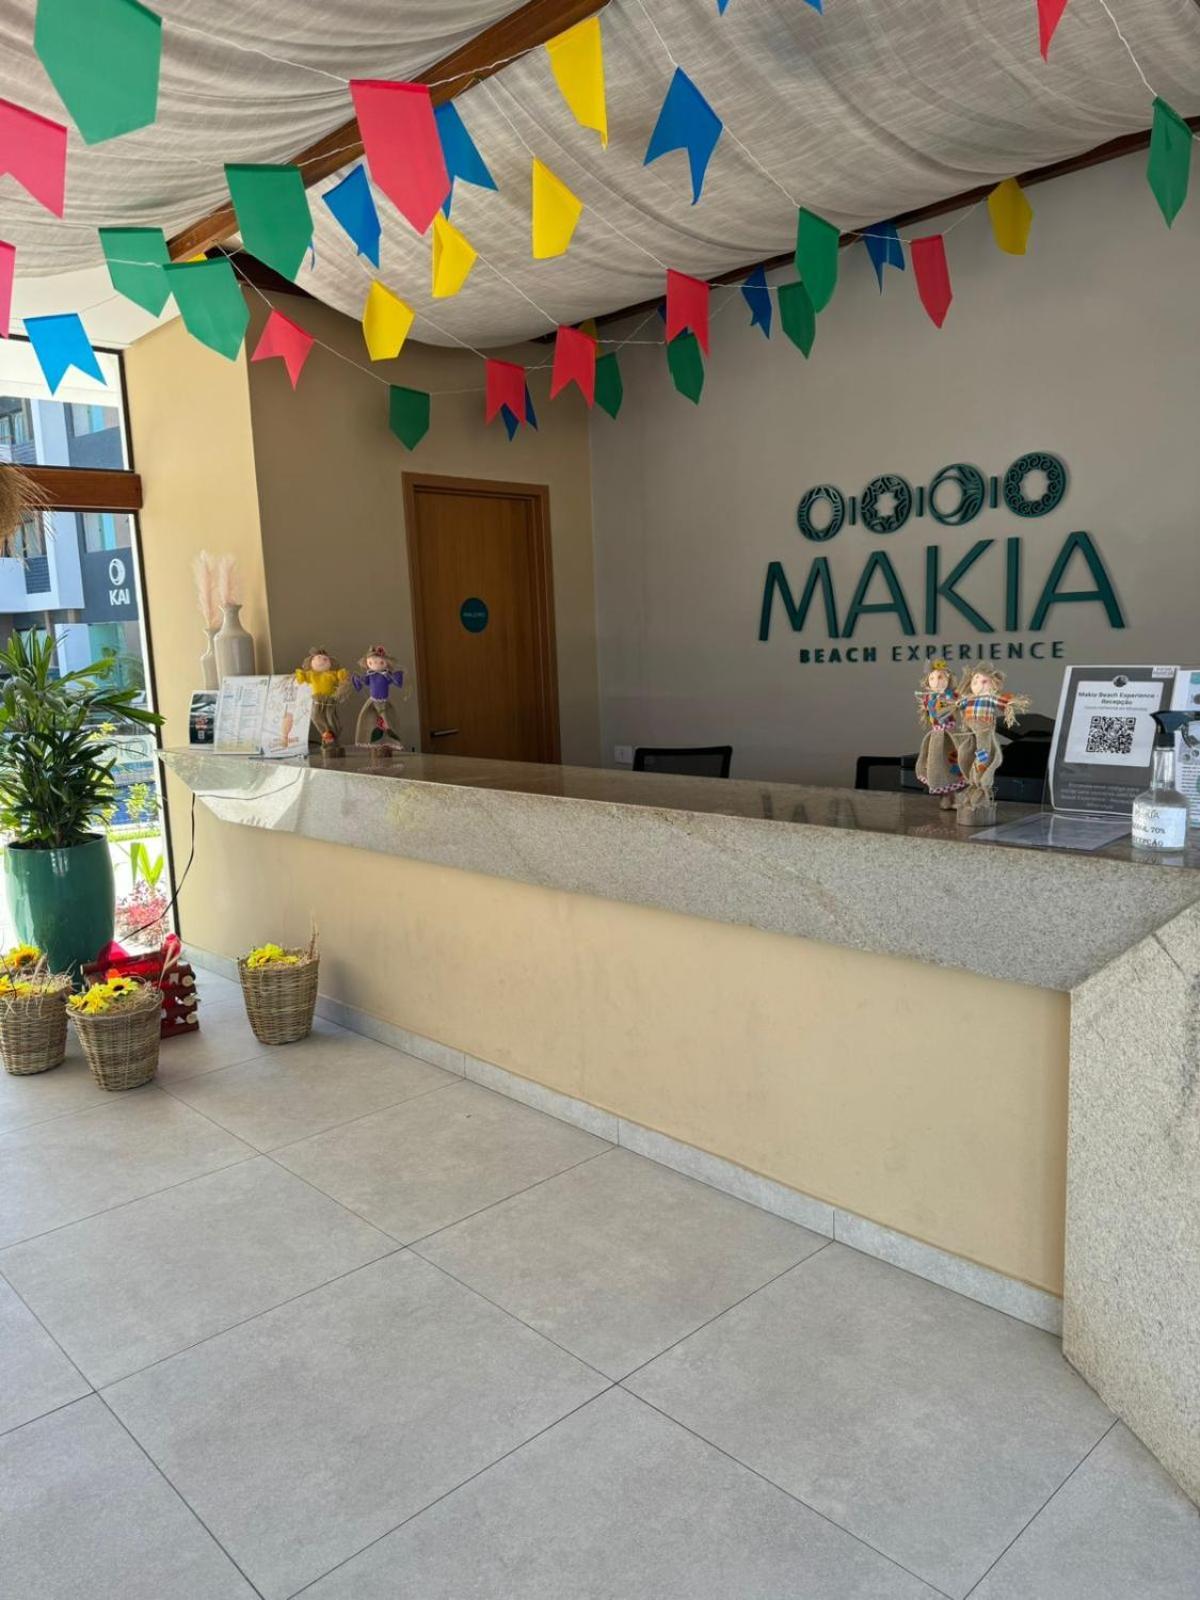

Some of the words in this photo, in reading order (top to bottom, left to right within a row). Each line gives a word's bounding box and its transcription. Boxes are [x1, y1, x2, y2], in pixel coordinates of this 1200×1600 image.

[109, 588, 130, 606] KAI
[758, 530, 1126, 641] MAKIA
[799, 646, 877, 664] BEACH
[892, 641, 1065, 662] EXPERIENCE
